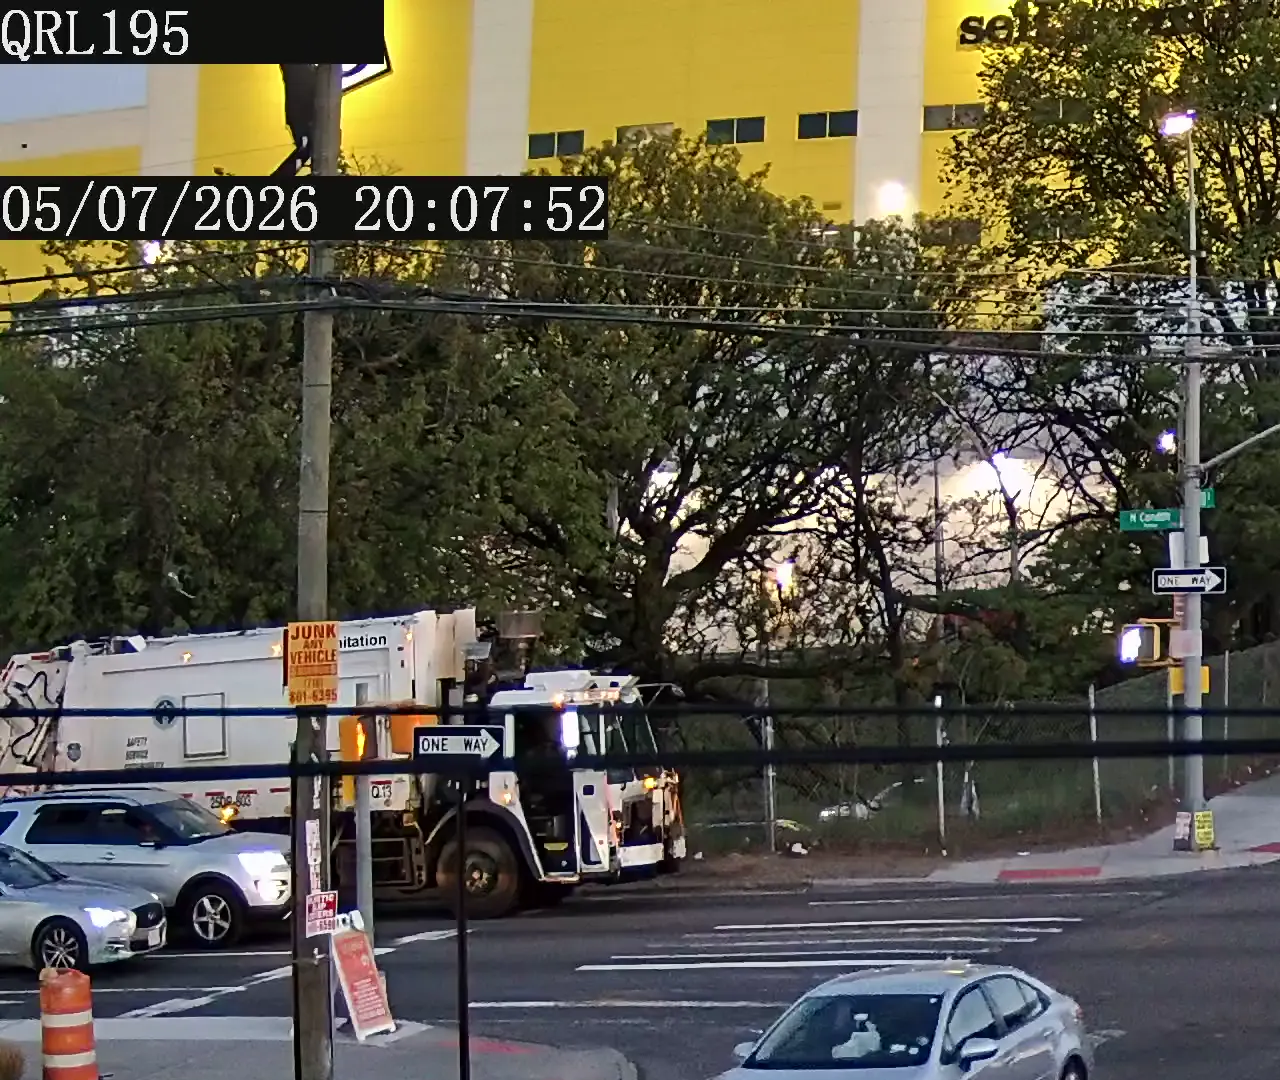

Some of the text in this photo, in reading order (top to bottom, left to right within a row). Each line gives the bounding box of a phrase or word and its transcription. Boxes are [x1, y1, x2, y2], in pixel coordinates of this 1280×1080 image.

[1160, 575, 1212, 586] ONE WAY
[291, 624, 336, 640] JUNK
[302, 639, 324, 649] ANY
[290, 649, 337, 664] VEHICLE
[421, 737, 489, 752] ONE WAY
